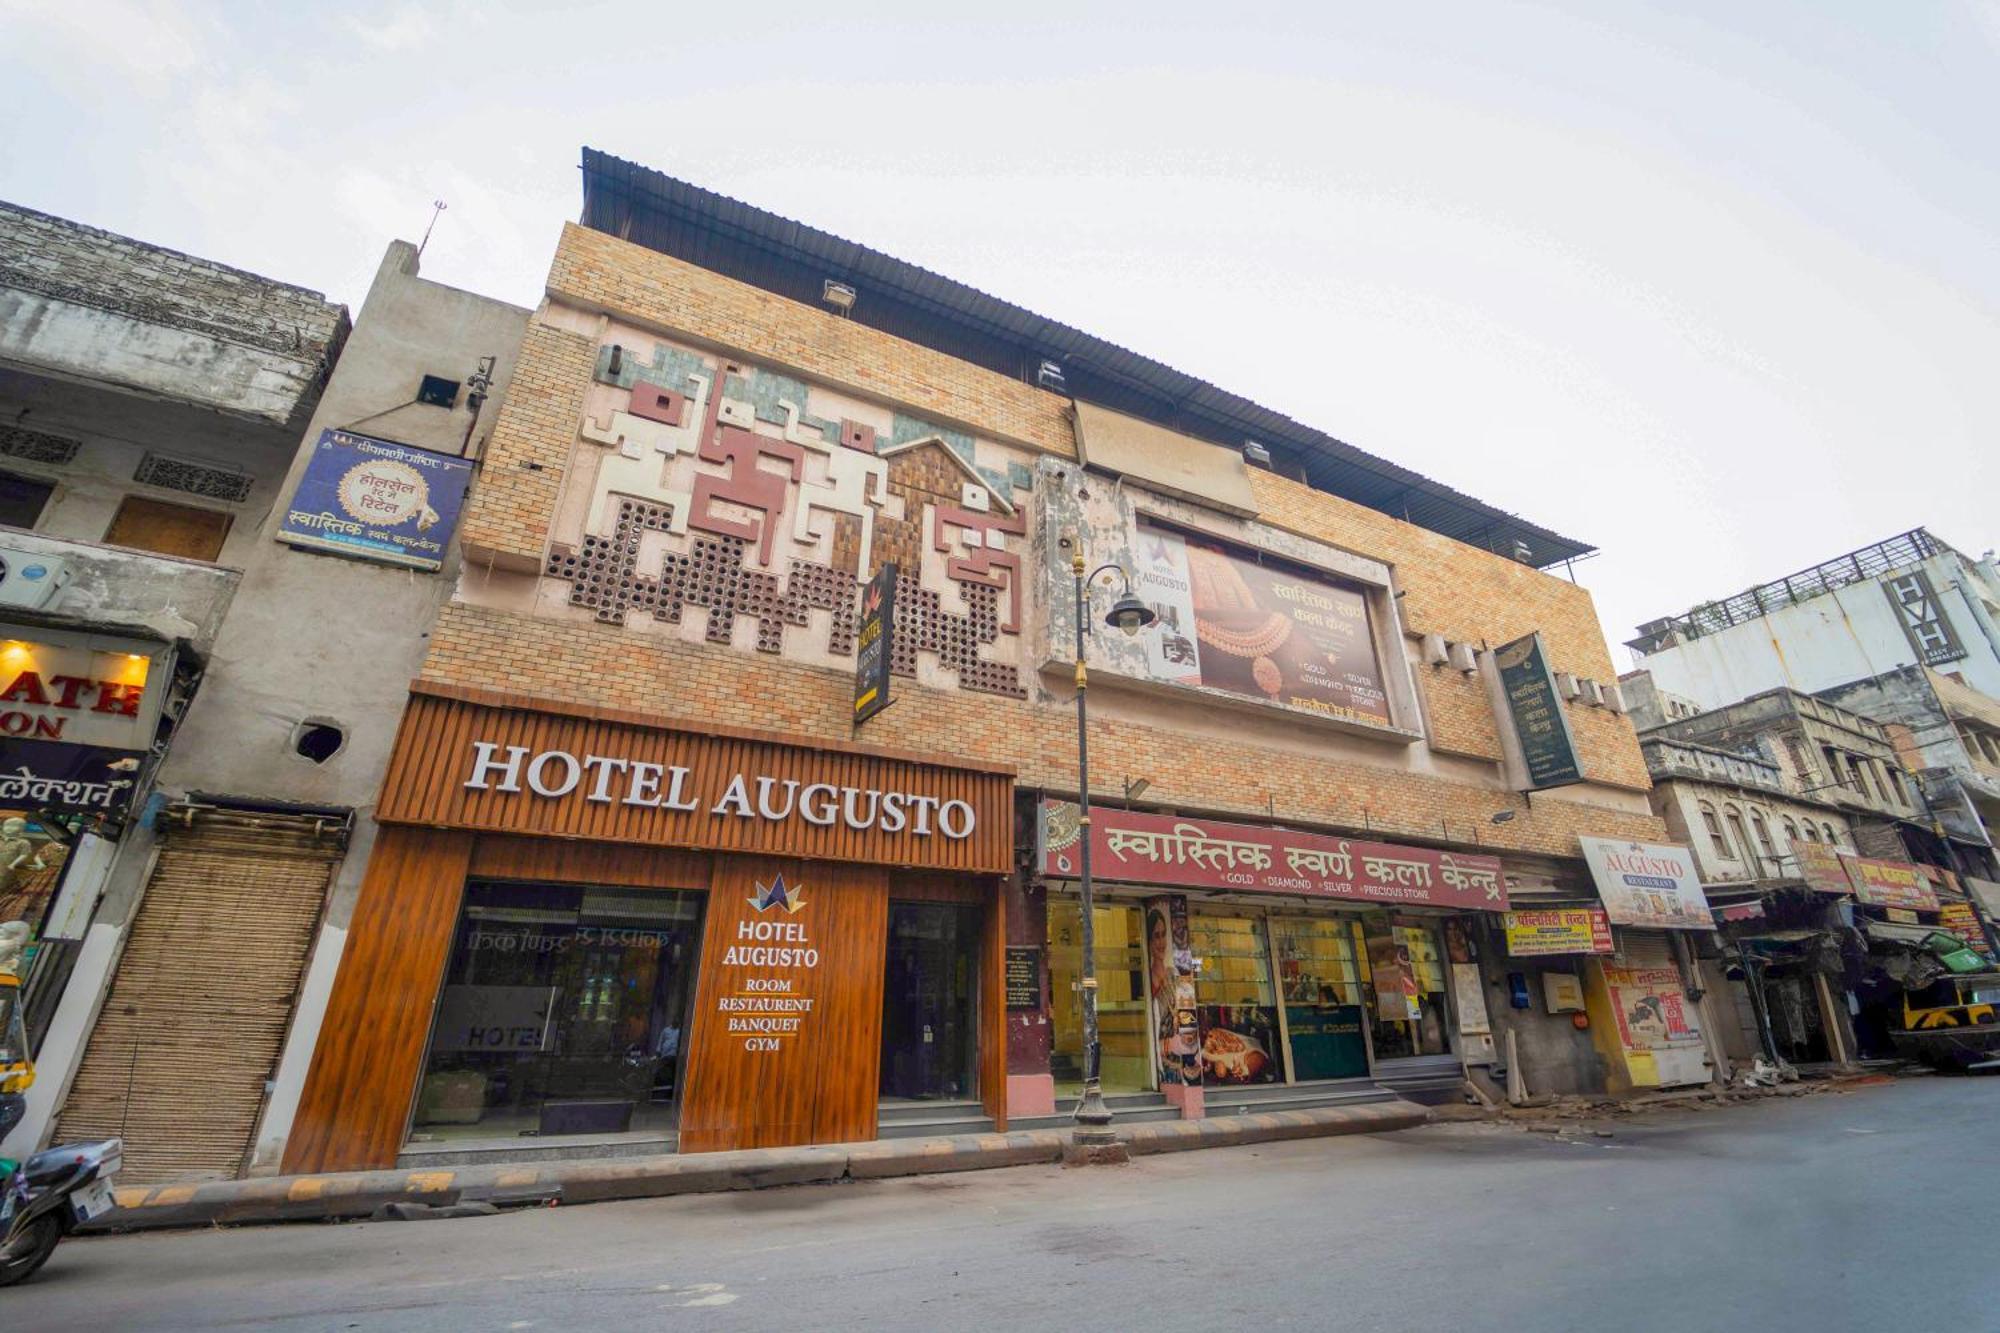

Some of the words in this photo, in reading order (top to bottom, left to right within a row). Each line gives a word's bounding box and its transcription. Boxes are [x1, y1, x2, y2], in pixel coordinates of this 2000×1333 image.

[360, 473, 416, 494] होलसेल
[361, 494, 398, 514] रिटेल
[289, 511, 365, 536] स्वास्तिक
[1142, 572, 1188, 592] AUGUSTO
[463, 741, 699, 812] HOTEL
[711, 773, 976, 840] AUGUSTO
[1104, 824, 1272, 872] स्वास्तिक
[1284, 841, 1354, 881] स्वर्ण
[1362, 856, 1433, 887] कला
[1438, 853, 1502, 901] केन्द्र
[1606, 854, 1684, 878] AUGUSTO
[1227, 873, 1254, 885] GOLD
[1267, 876, 1312, 890] DIAMOND
[1323, 882, 1352, 893] SILVER
[1363, 885, 1404, 897] PRECIOUS
[1404, 889, 1430, 900] STONE
[738, 921, 808, 942] HOTEL
[722, 946, 818, 968] AUGUSTO
[746, 980, 791, 992] ROOM
[718, 998, 814, 1012] RESTAURENT
[728, 1018, 800, 1033] BANQUET
[745, 1038, 780, 1051] GYM
